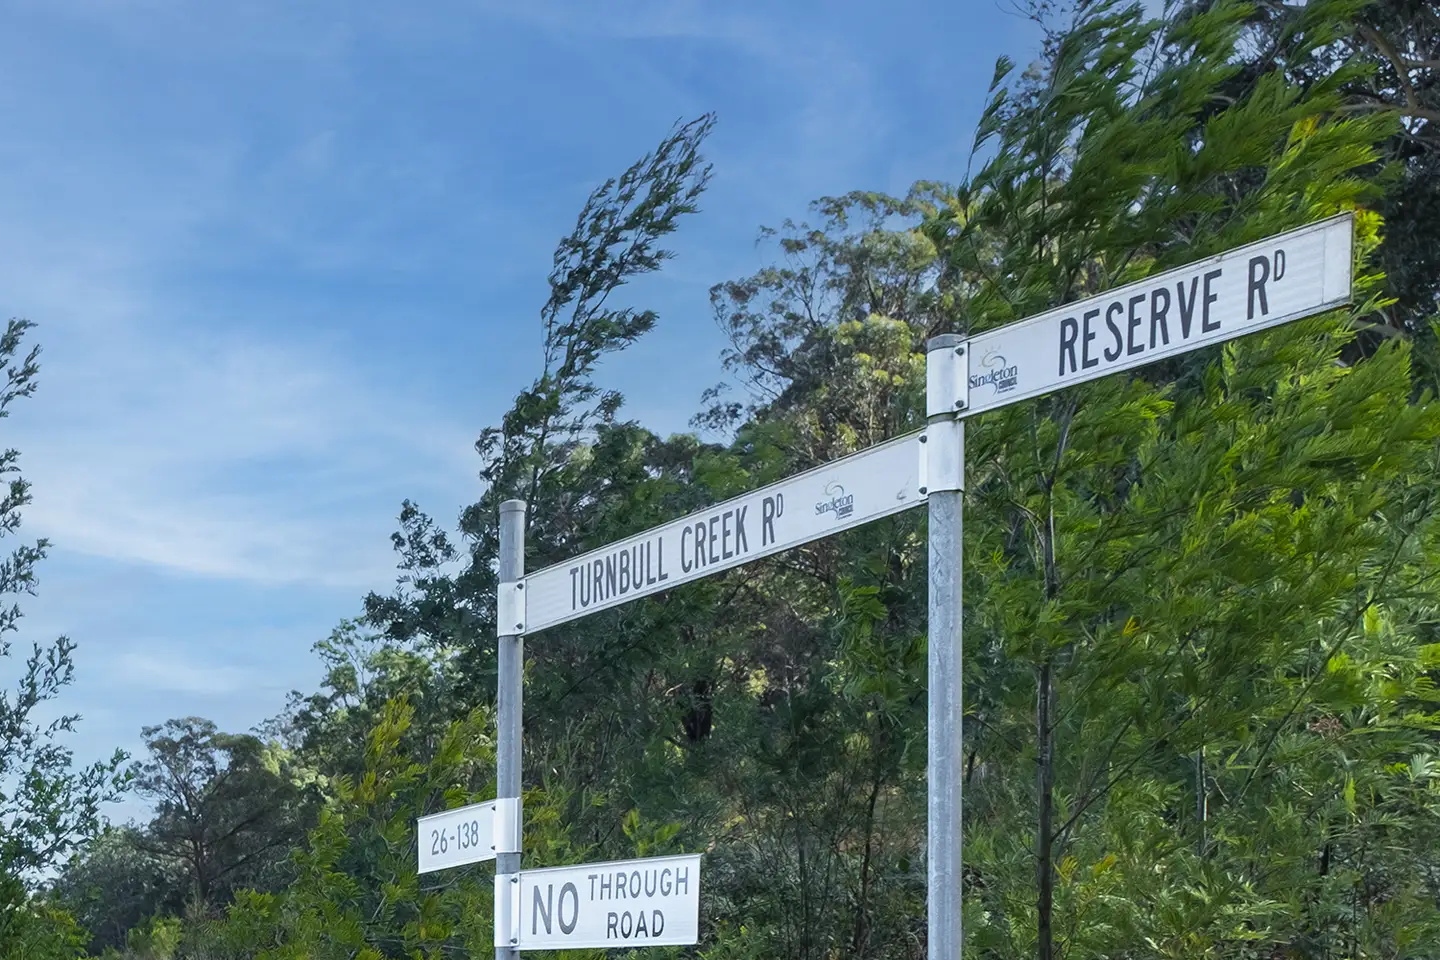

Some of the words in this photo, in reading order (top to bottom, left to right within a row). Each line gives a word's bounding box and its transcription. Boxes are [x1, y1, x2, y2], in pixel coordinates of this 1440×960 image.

[1058, 269, 1223, 377] RESERVE
[969, 365, 1018, 395] Singleton
[570, 536, 669, 611] TURNBULL
[680, 505, 749, 574] CREEK
[431, 820, 479, 855] 26-138
[588, 866, 689, 901] THROUGH
[532, 881, 580, 935] NO
[607, 909, 665, 939] ROAD
